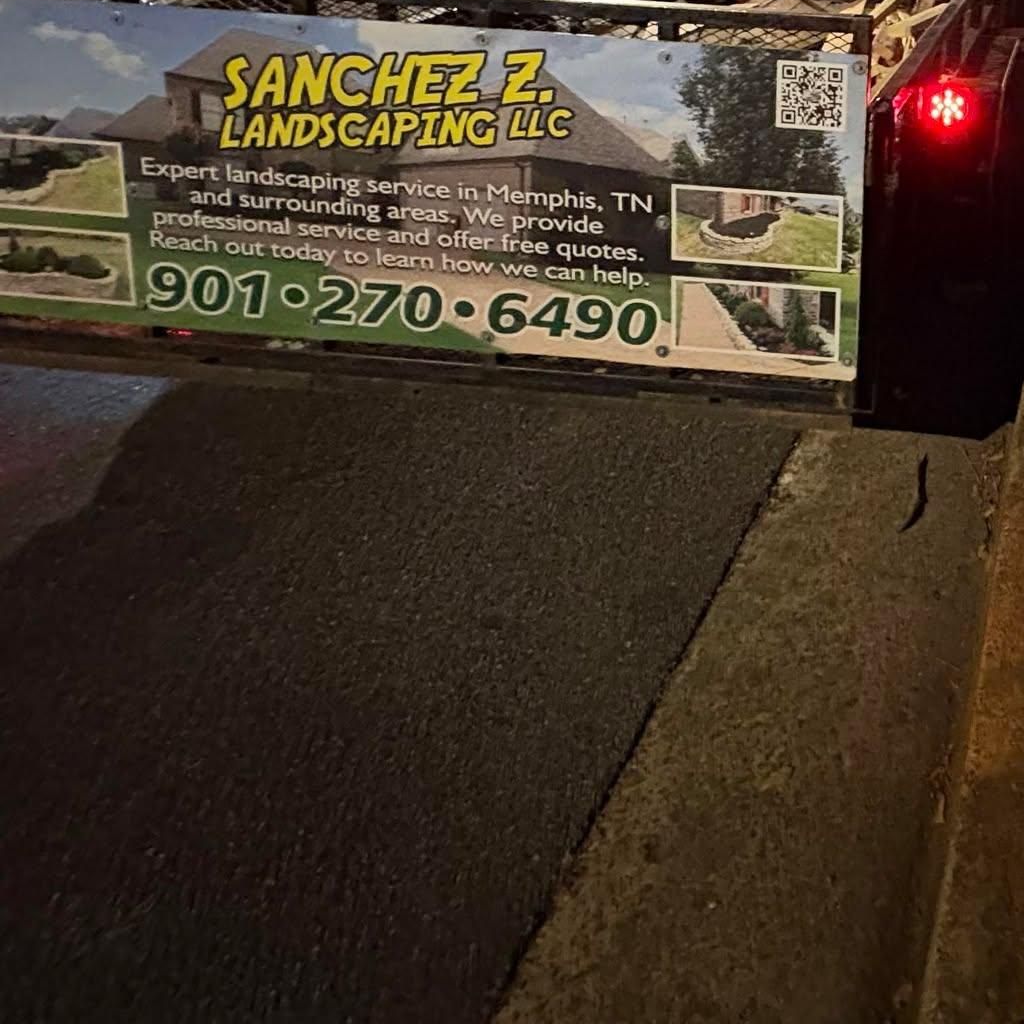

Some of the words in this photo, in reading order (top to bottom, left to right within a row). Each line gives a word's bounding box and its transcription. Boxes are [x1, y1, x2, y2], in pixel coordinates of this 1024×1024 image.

[223, 51, 486, 110] SANCHEZ
[501, 49, 555, 106] Z.
[218, 109, 497, 149] LANDSCAPING
[507, 108, 574, 139] LLC
[140, 157, 220, 181] Expert
[226, 164, 360, 197] landscaping
[367, 179, 450, 199] service
[457, 182, 478, 201] in
[486, 183, 603, 212] Memphis,
[609, 192, 653, 213] TN
[189, 188, 231, 206] and
[238, 193, 381, 223] surrounding
[387, 207, 456, 224] areas.
[462, 206, 504, 227] We
[511, 215, 604, 235] provide
[150, 231, 218, 253] Reach
[225, 241, 264, 257] out
[271, 243, 337, 267] today
[344, 250, 369, 265] to
[376, 248, 434, 269] learn
[442, 253, 494, 274] how
[500, 262, 538, 278] we
[545, 266, 584, 281] can
[593, 265, 650, 290] help.
[153, 210, 290, 235] professional
[299, 223, 381, 242] service
[387, 228, 430, 246] and
[437, 231, 494, 251] offer
[501, 233, 549, 255] free
[556, 242, 645, 262] quotes.
